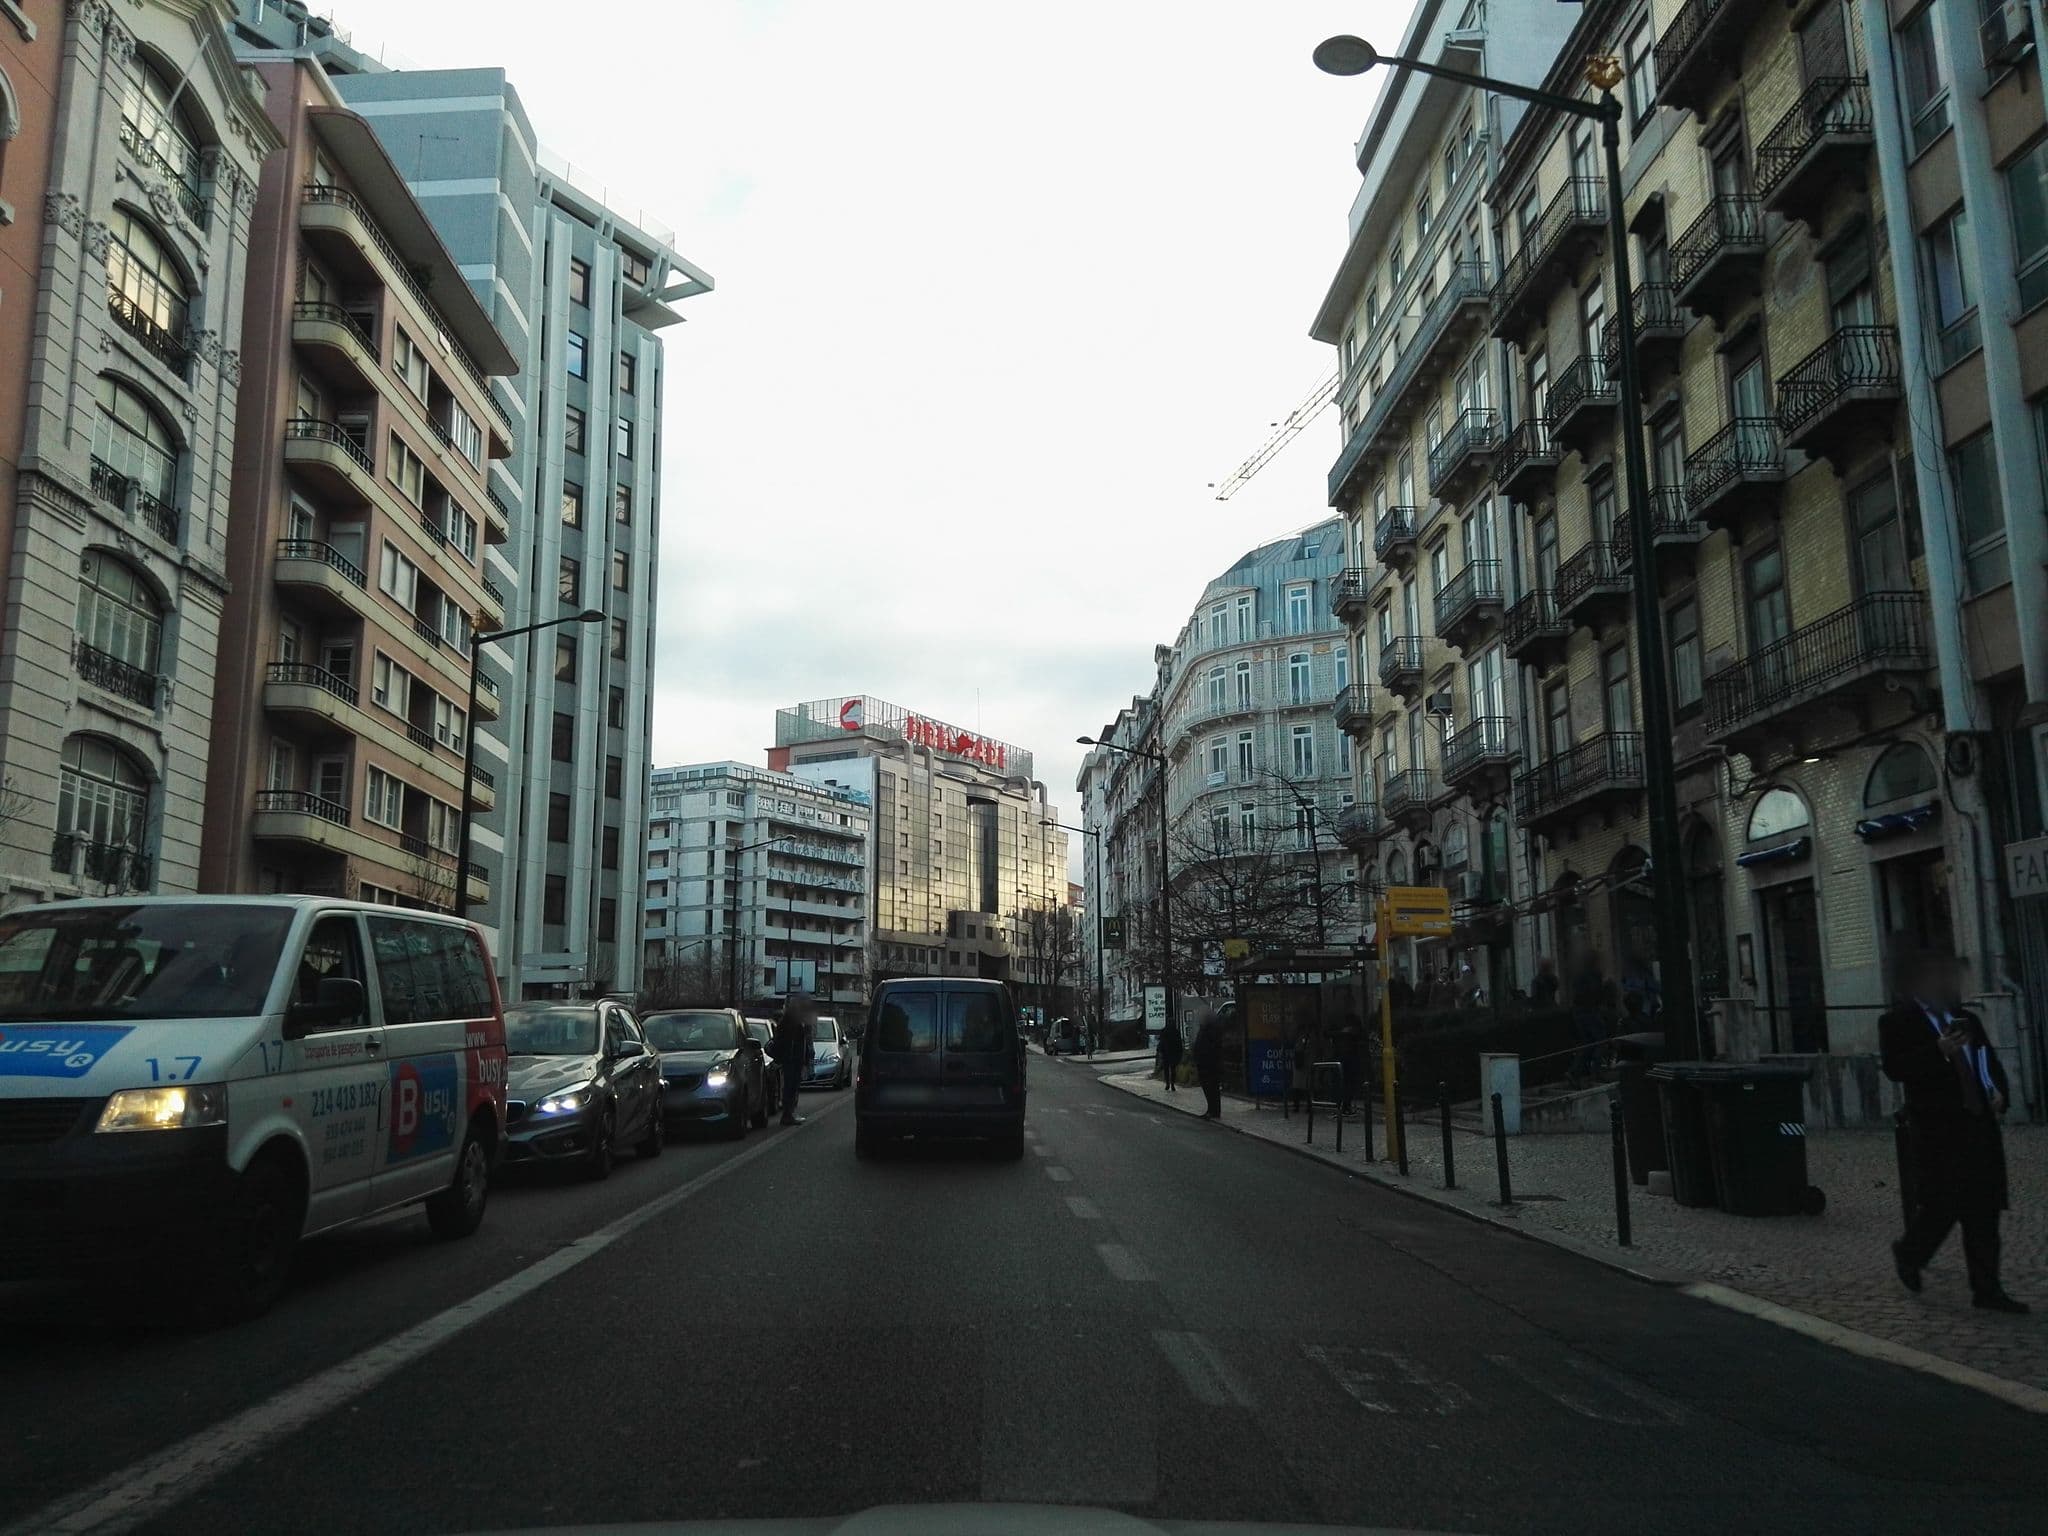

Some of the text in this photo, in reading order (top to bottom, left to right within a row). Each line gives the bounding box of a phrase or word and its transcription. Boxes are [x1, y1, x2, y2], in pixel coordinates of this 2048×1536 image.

[0, 1040, 86, 1057] usy
[146, 1056, 202, 1081] 1.7
[312, 1082, 377, 1117] 214 418 182
